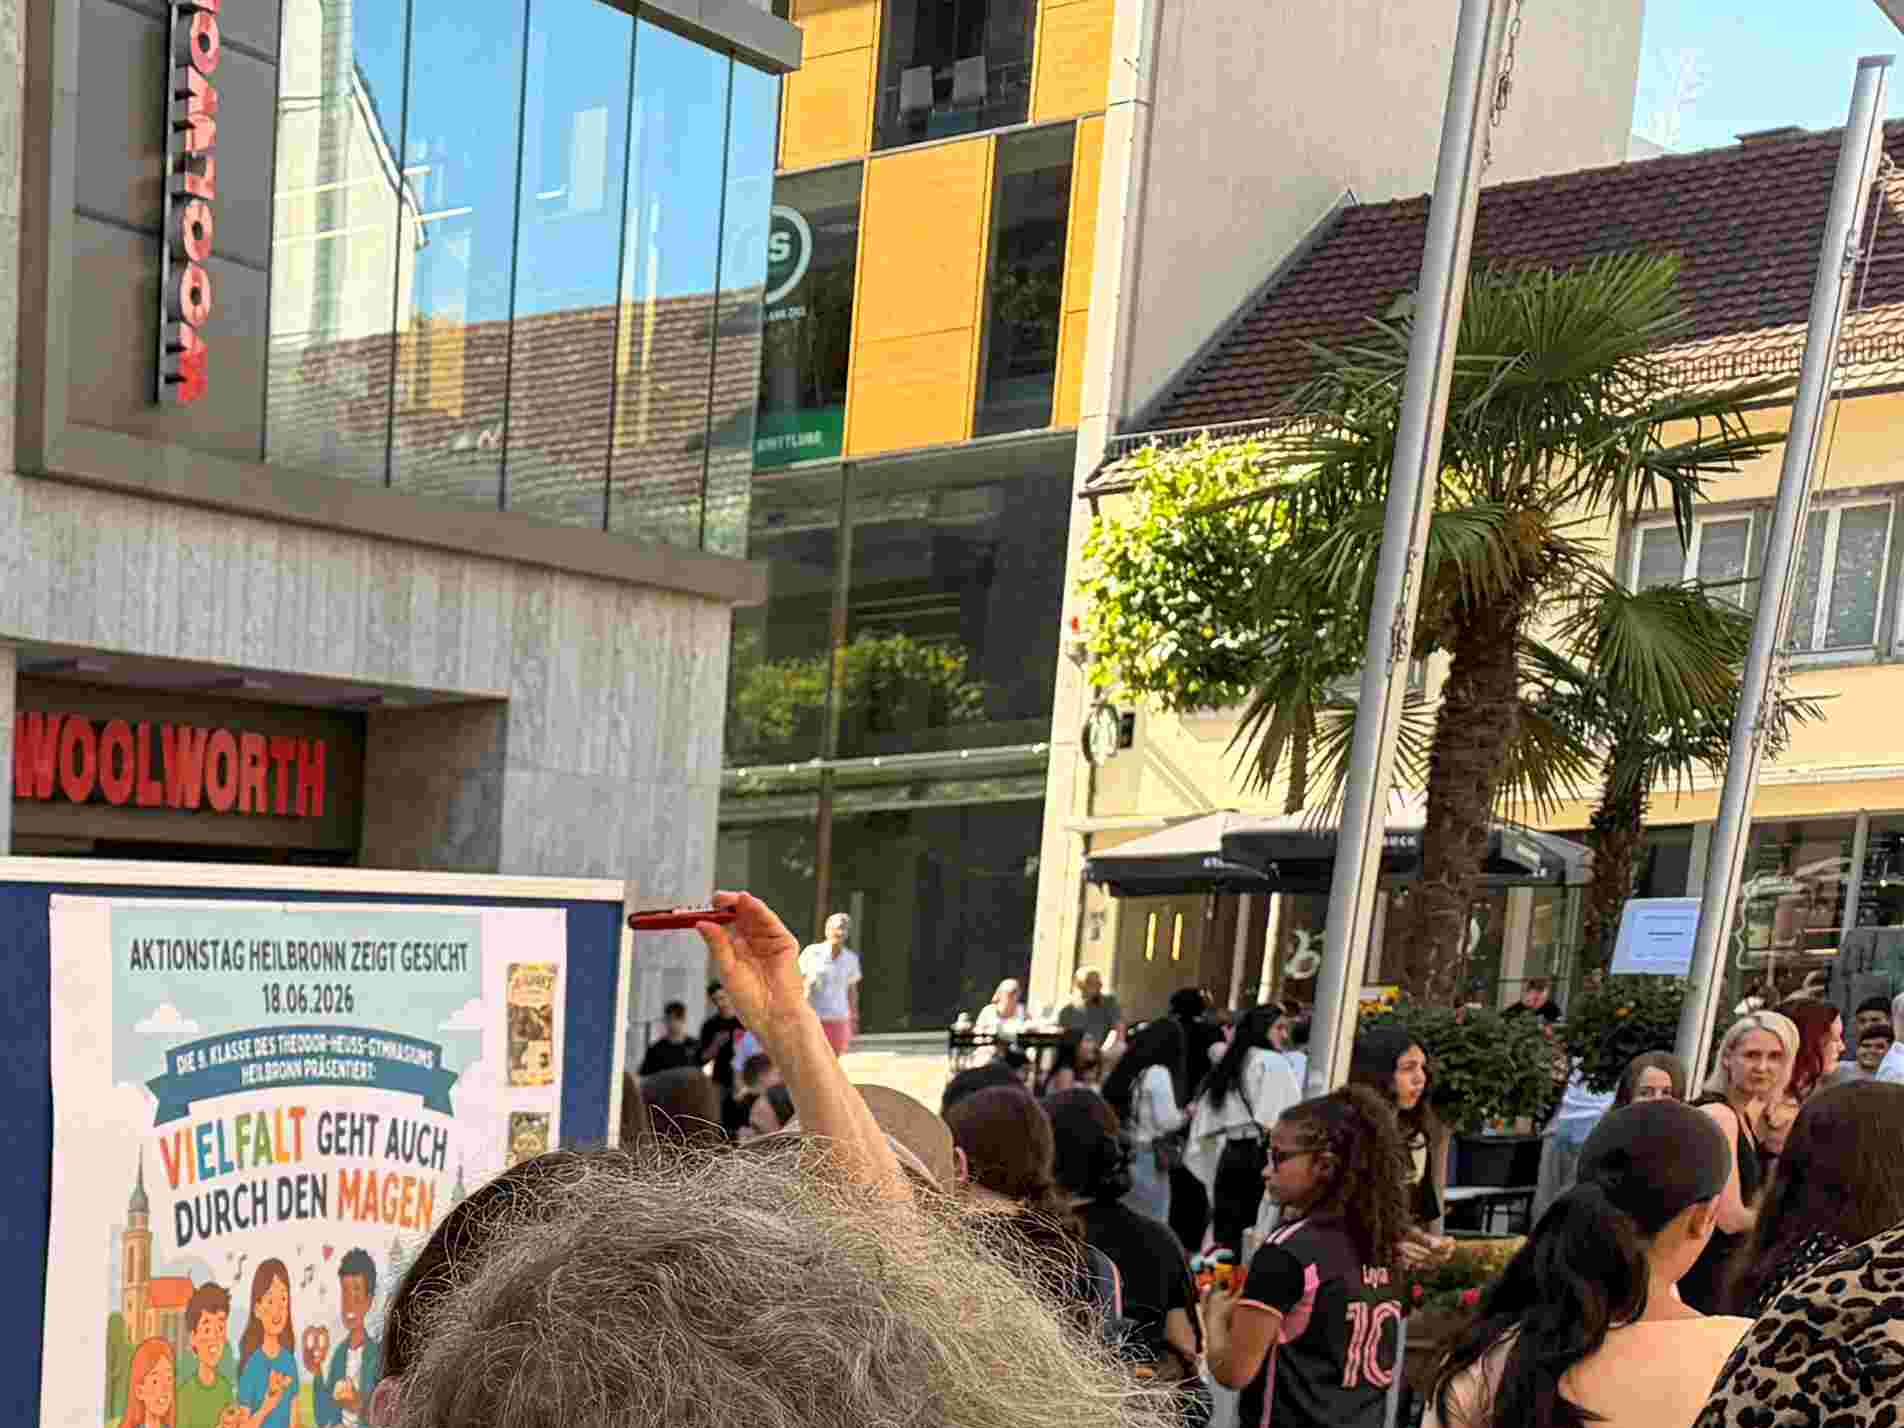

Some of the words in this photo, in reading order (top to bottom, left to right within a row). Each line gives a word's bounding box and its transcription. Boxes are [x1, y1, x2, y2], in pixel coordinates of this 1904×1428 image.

[14, 708, 328, 817] WOOLWORTH
[130, 938, 245, 973] AKTIONSTAG
[248, 940, 346, 973] HEILBRONN
[350, 941, 398, 973] ZEIGT
[400, 941, 468, 973] GESICHT
[261, 982, 355, 1015] 18.06.2026
[209, 1038, 255, 1067] KLASSE
[255, 1036, 277, 1059] DES
[240, 1059, 303, 1087] HEILBRONN
[160, 1106, 306, 1190] VIELFALT
[317, 1110, 379, 1157] GEHT
[384, 1117, 448, 1171] AUCH
[174, 1179, 268, 1248] DURCH
[277, 1173, 328, 1221] DEN
[337, 1167, 436, 1232] MAGEN
[1344, 1300, 1403, 1389] 10
